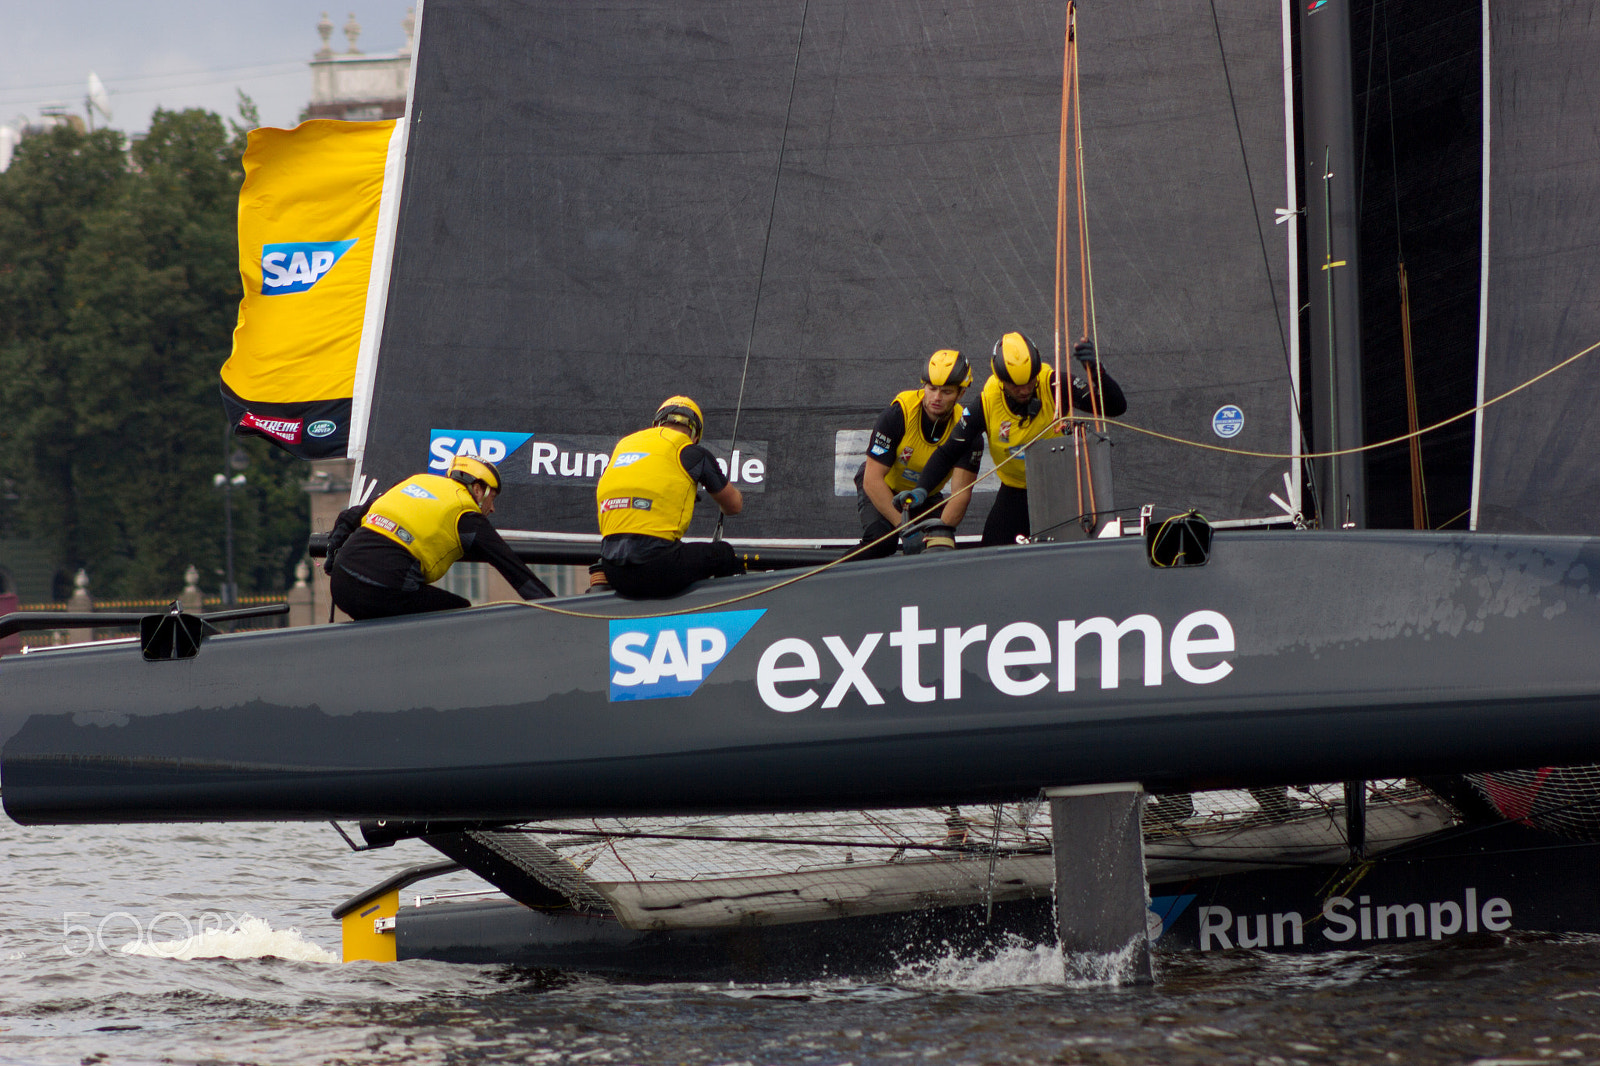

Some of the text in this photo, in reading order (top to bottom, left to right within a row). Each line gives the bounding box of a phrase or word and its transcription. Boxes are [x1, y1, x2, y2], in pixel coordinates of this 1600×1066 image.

[262, 251, 335, 287] SAP
[429, 437, 610, 477] SAP Run
[615, 454, 640, 466] SAP
[403, 484, 429, 498] SAP
[611, 605, 1235, 713] SAP extreme
[1199, 905, 1303, 952] Run
[1322, 887, 1513, 942] Simple
